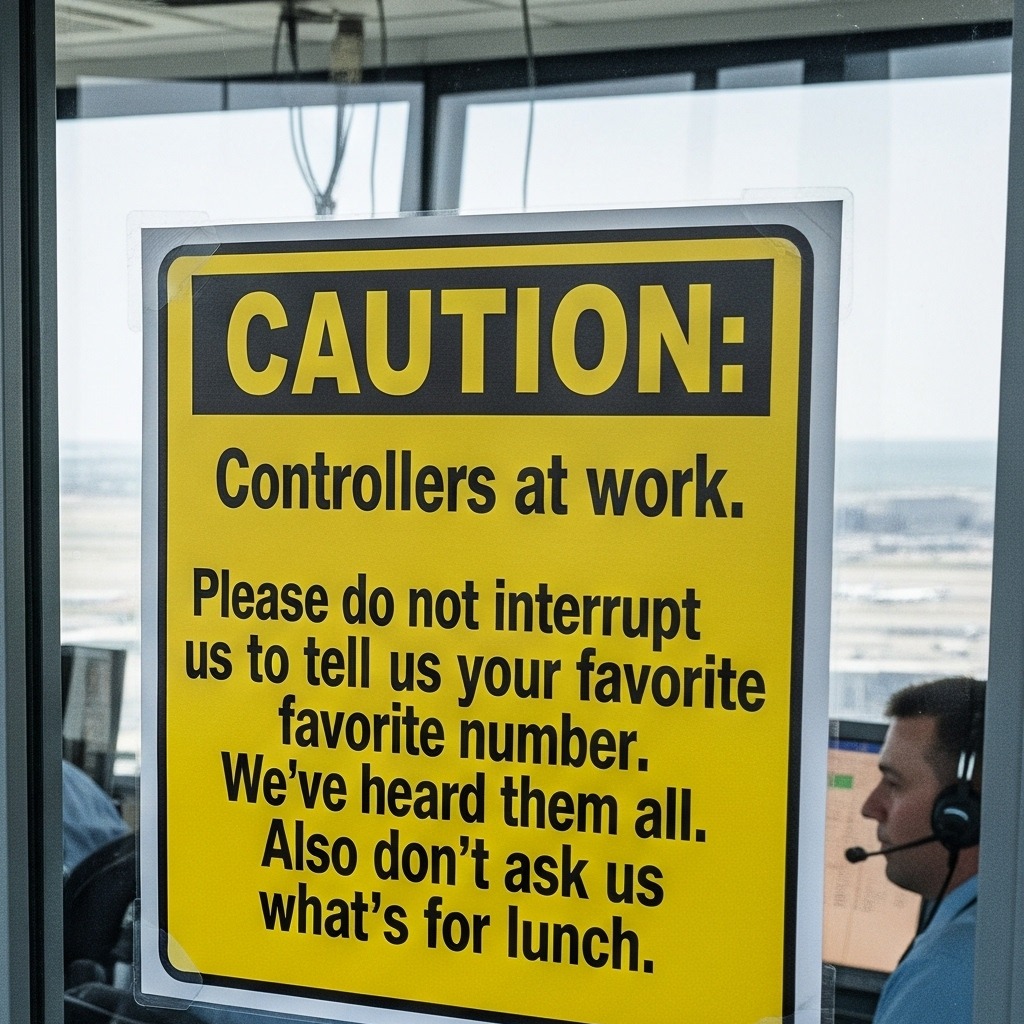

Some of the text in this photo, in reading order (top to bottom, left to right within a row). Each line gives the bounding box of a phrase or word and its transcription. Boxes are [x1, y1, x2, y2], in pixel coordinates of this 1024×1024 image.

[227, 284, 744, 395] CAUTION:
[217, 448, 743, 518] Controllers at work.
[194, 568, 700, 652] Please do not interrupt
[186, 635, 765, 712] us to tell us your favorite
[279, 694, 648, 771] favorite number.
[362, 763, 485, 823] heard
[501, 775, 617, 835] them
[635, 787, 705, 842] all.
[261, 819, 357, 876] Also
[505, 844, 589, 899] ask
[607, 863, 663, 907] us
[424, 896, 490, 953] for
[509, 905, 653, 973] lunch.
